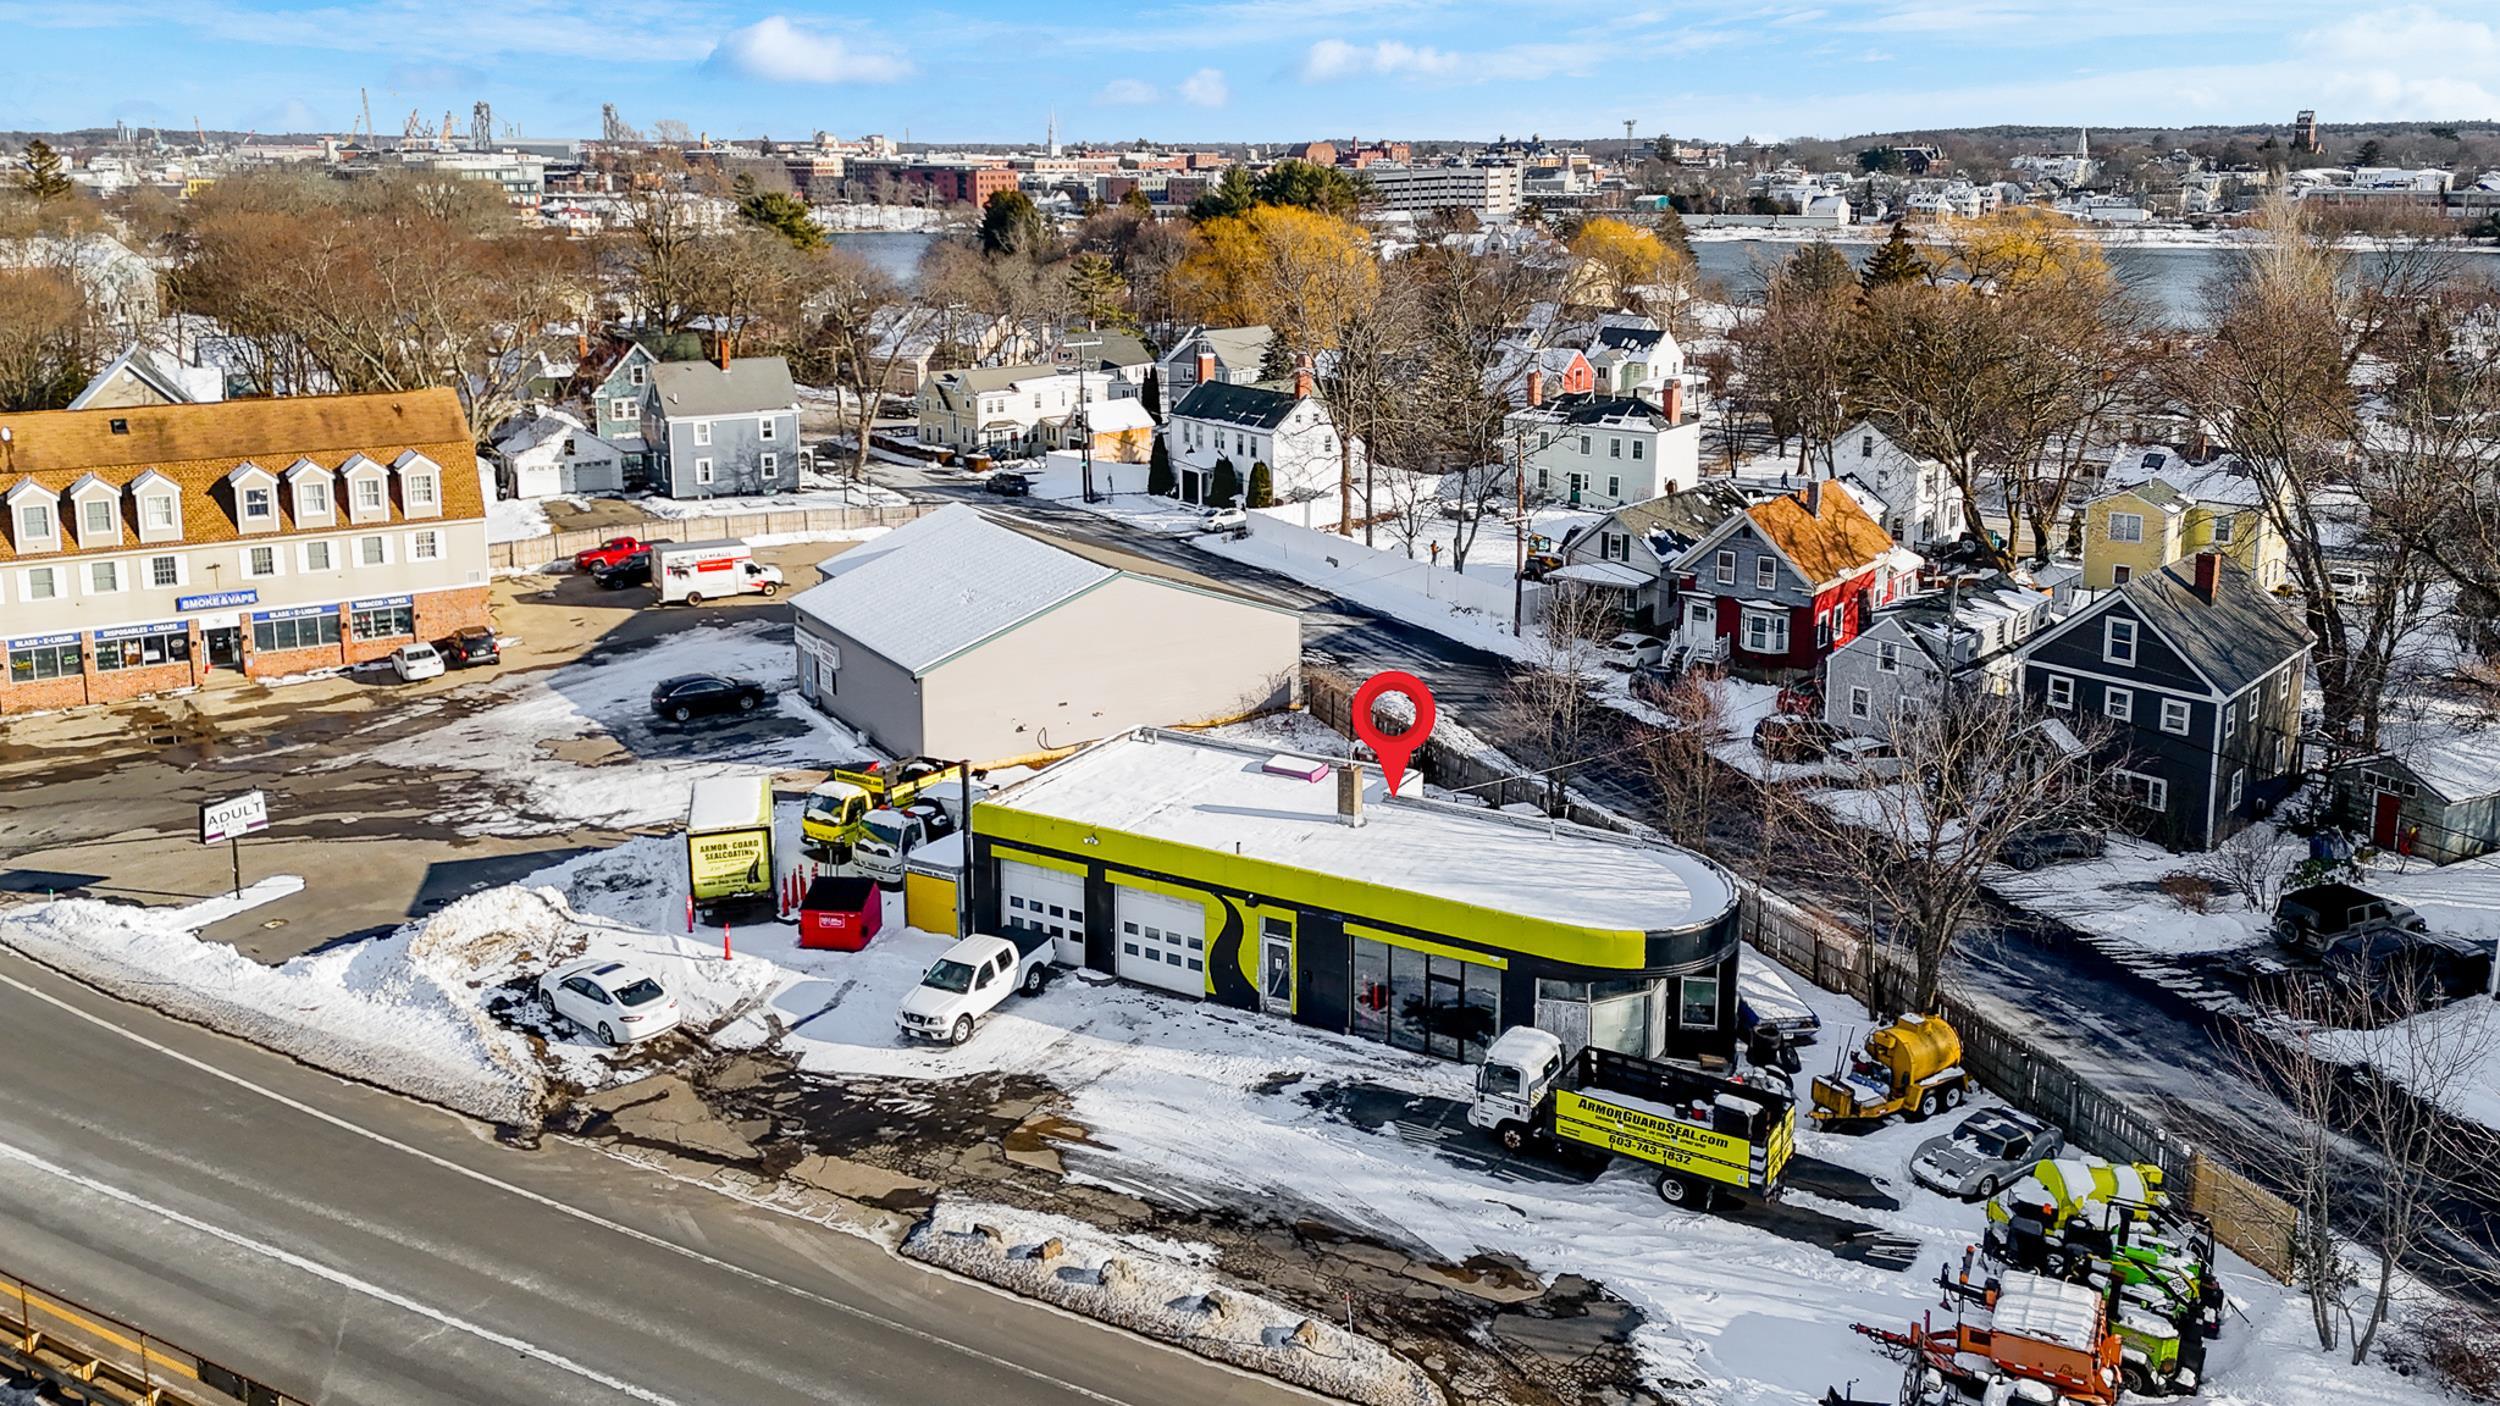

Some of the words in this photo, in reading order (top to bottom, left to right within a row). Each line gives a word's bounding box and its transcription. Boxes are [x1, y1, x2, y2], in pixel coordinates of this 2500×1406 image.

[182, 597, 219, 610] SMOKE
[228, 592, 256, 605] VAPE
[269, 610, 290, 619] GLASS
[103, 625, 148, 638] DISPOSABLES
[153, 623, 178, 633] CIGARS
[15, 637, 39, 648] GLASS
[207, 801, 261, 828] ADULT
[1608, 1134, 1692, 1165] 603-743-1832
